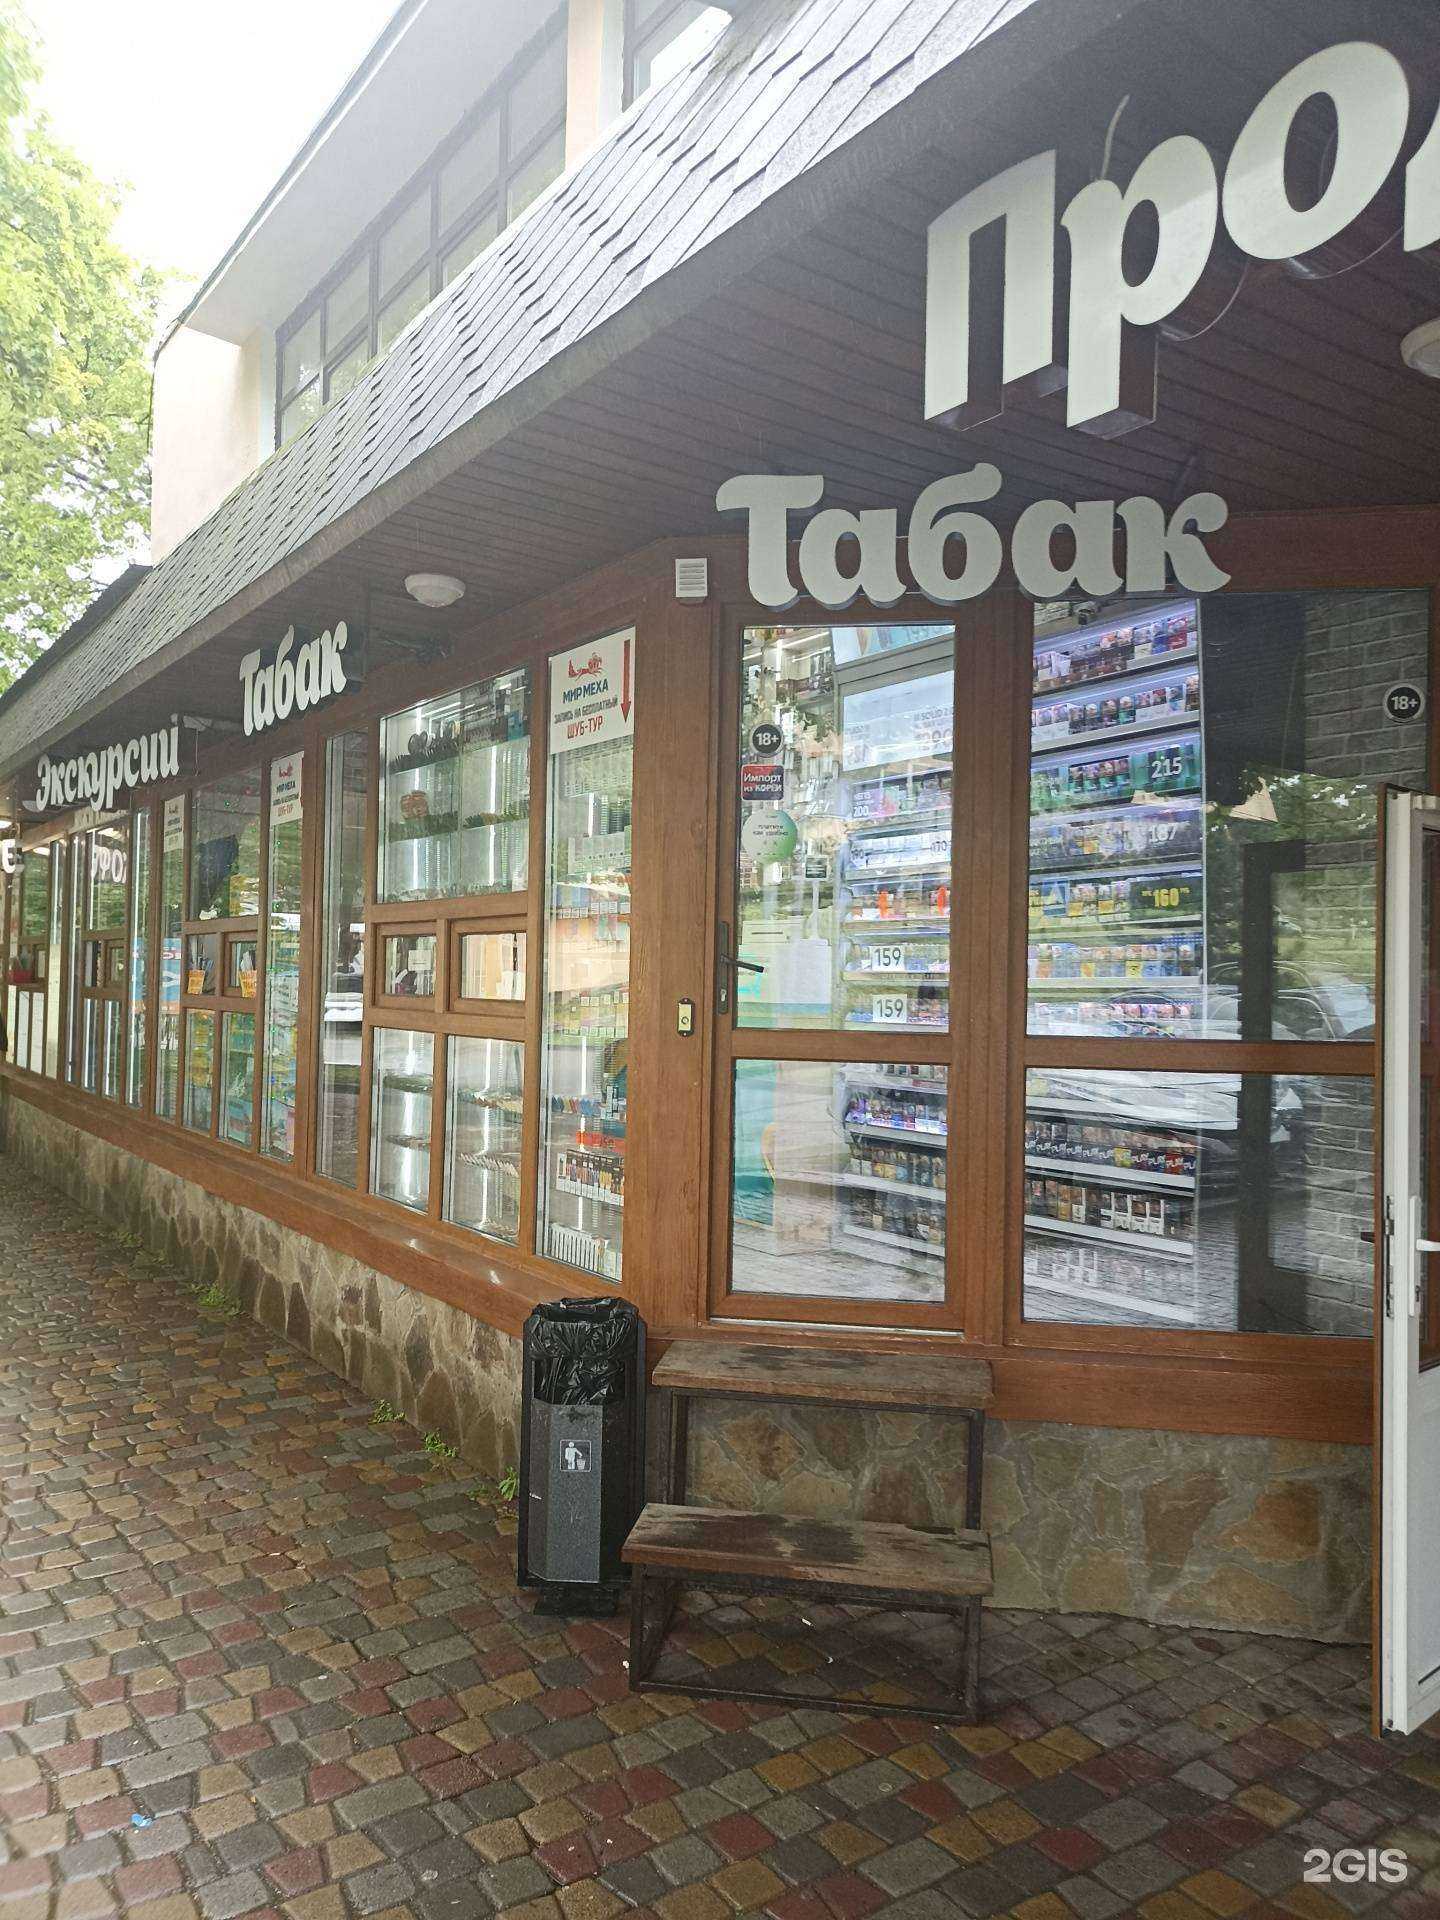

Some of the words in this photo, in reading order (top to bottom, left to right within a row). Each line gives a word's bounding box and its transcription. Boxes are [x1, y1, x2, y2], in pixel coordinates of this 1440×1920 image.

[715, 462, 1232, 608] Табак
[239, 620, 348, 737] Табак
[562, 686, 583, 704] МИР
[582, 678, 609, 698] МЕХА
[1391, 695, 1418, 710] 18+
[567, 715, 603, 739] ШУБ-ТУР
[755, 732, 779, 746] 18+
[1151, 756, 1182, 779] 215
[744, 773, 782, 785] Импорт
[1152, 887, 1180, 908] 160
[874, 947, 901, 967] 159
[876, 998, 903, 1018] 159
